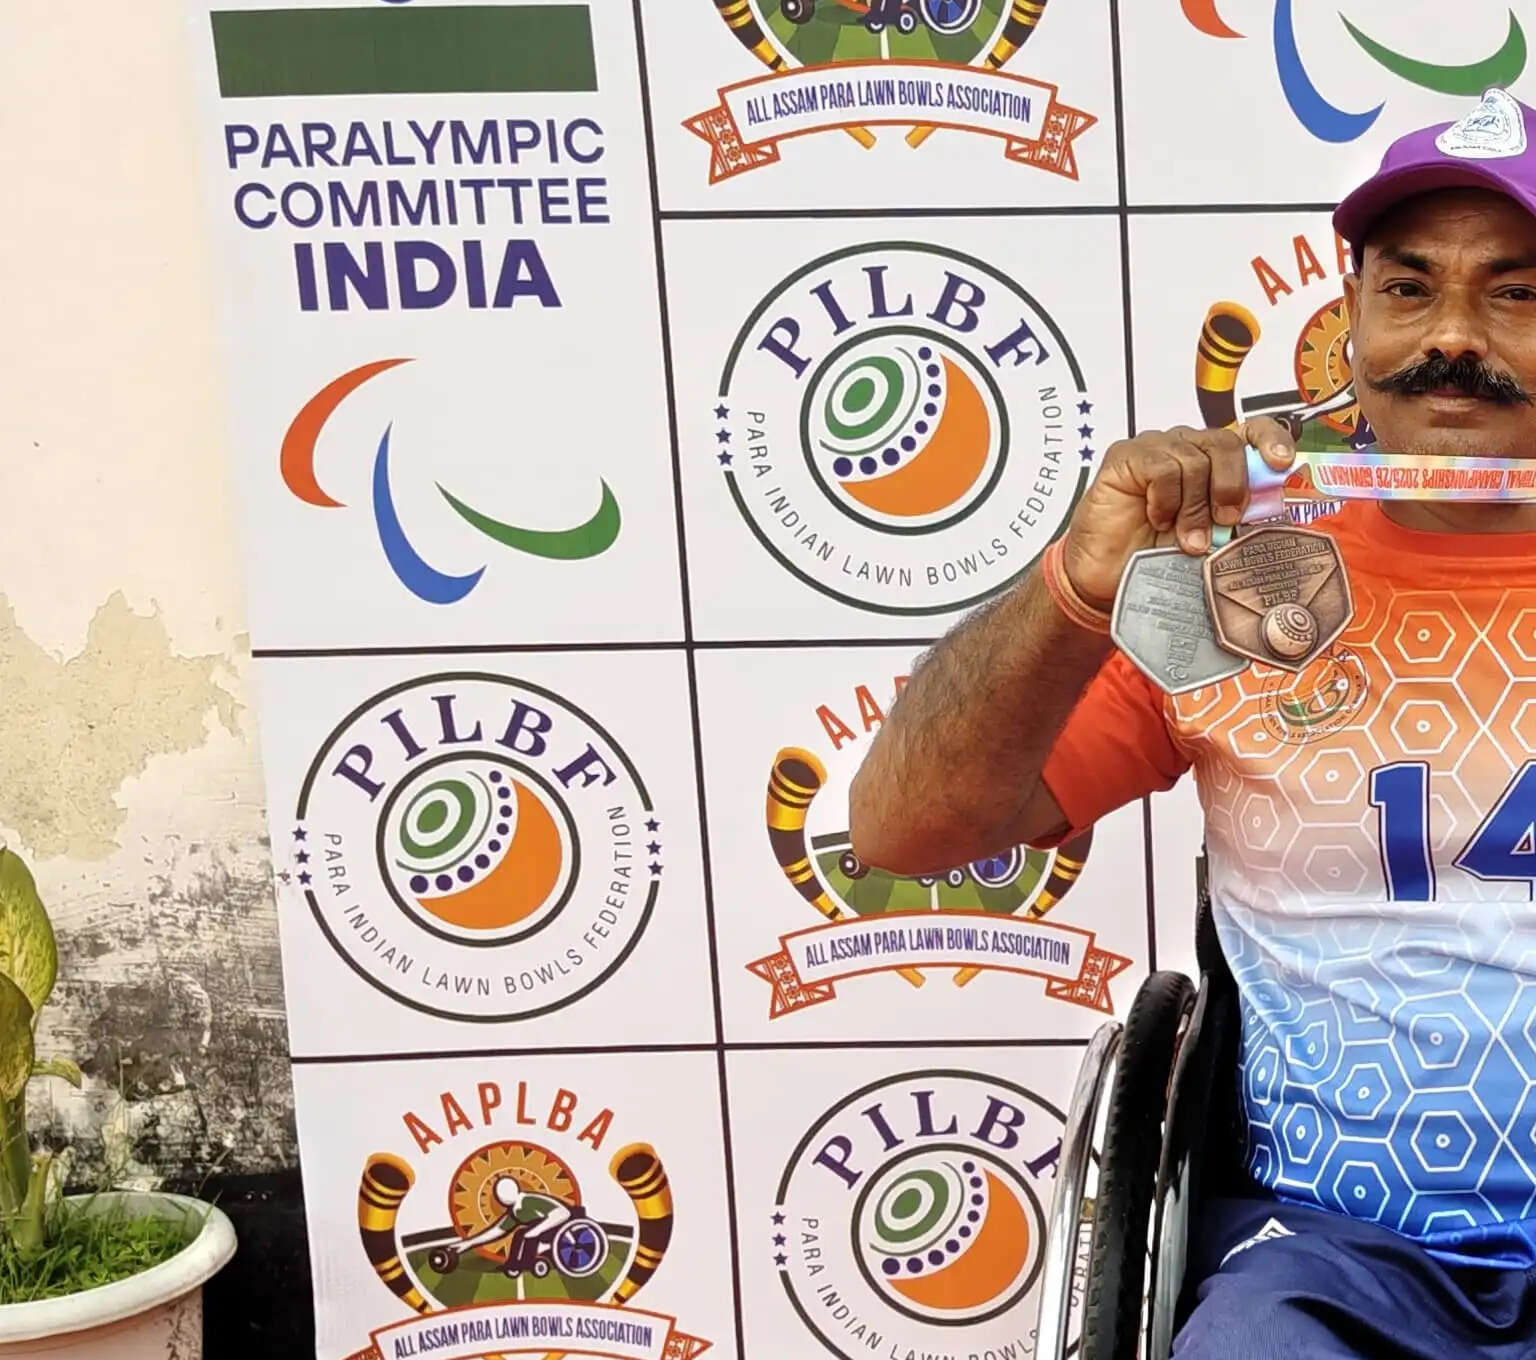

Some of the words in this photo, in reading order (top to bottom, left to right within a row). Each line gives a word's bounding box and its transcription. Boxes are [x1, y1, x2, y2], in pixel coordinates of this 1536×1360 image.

[747, 97, 771, 125] ALL
[773, 86, 818, 119] ASSAM
[820, 82, 855, 109] PARA
[858, 80, 894, 106] LAWN
[898, 80, 943, 105] BOWLS
[947, 84, 1031, 123] ASSOCIATION
[225, 119, 604, 168] PARALYMPIC
[235, 178, 609, 229] COMMITTEE
[294, 240, 561, 311] INDIA
[757, 265, 1050, 379] PILBF
[746, 411, 772, 477] PARA
[765, 488, 834, 561] INDIAN
[843, 555, 911, 586] LAWN
[927, 538, 1008, 586] BOWLS
[1009, 386, 1063, 539] FEDERATION
[331, 695, 617, 802] PILBF
[323, 834, 350, 896] PARA
[344, 905, 413, 973] INDIAN
[423, 967, 489, 995] LAWN
[505, 949, 583, 994] BOWLS
[583, 805, 633, 949] FEDERATION
[806, 943, 828, 968] ALL
[830, 933, 872, 962] ASSAM
[875, 930, 906, 953] PARA
[909, 928, 943, 951] LAWN
[947, 928, 988, 950] BOWLS
[992, 931, 1070, 965] ASSOCIATION
[403, 1081, 615, 1154] AAPLBA
[801, 1218, 824, 1276] PARA
[817, 1285, 881, 1350] INDIAN
[395, 1335, 418, 1359] ALL
[419, 1324, 460, 1353] ASSAM
[462, 1320, 493, 1343] PARA
[496, 1317, 529, 1340] LAWN
[533, 1317, 573, 1337] BOWLS
[577, 1318, 652, 1347] ASSOCIATION
